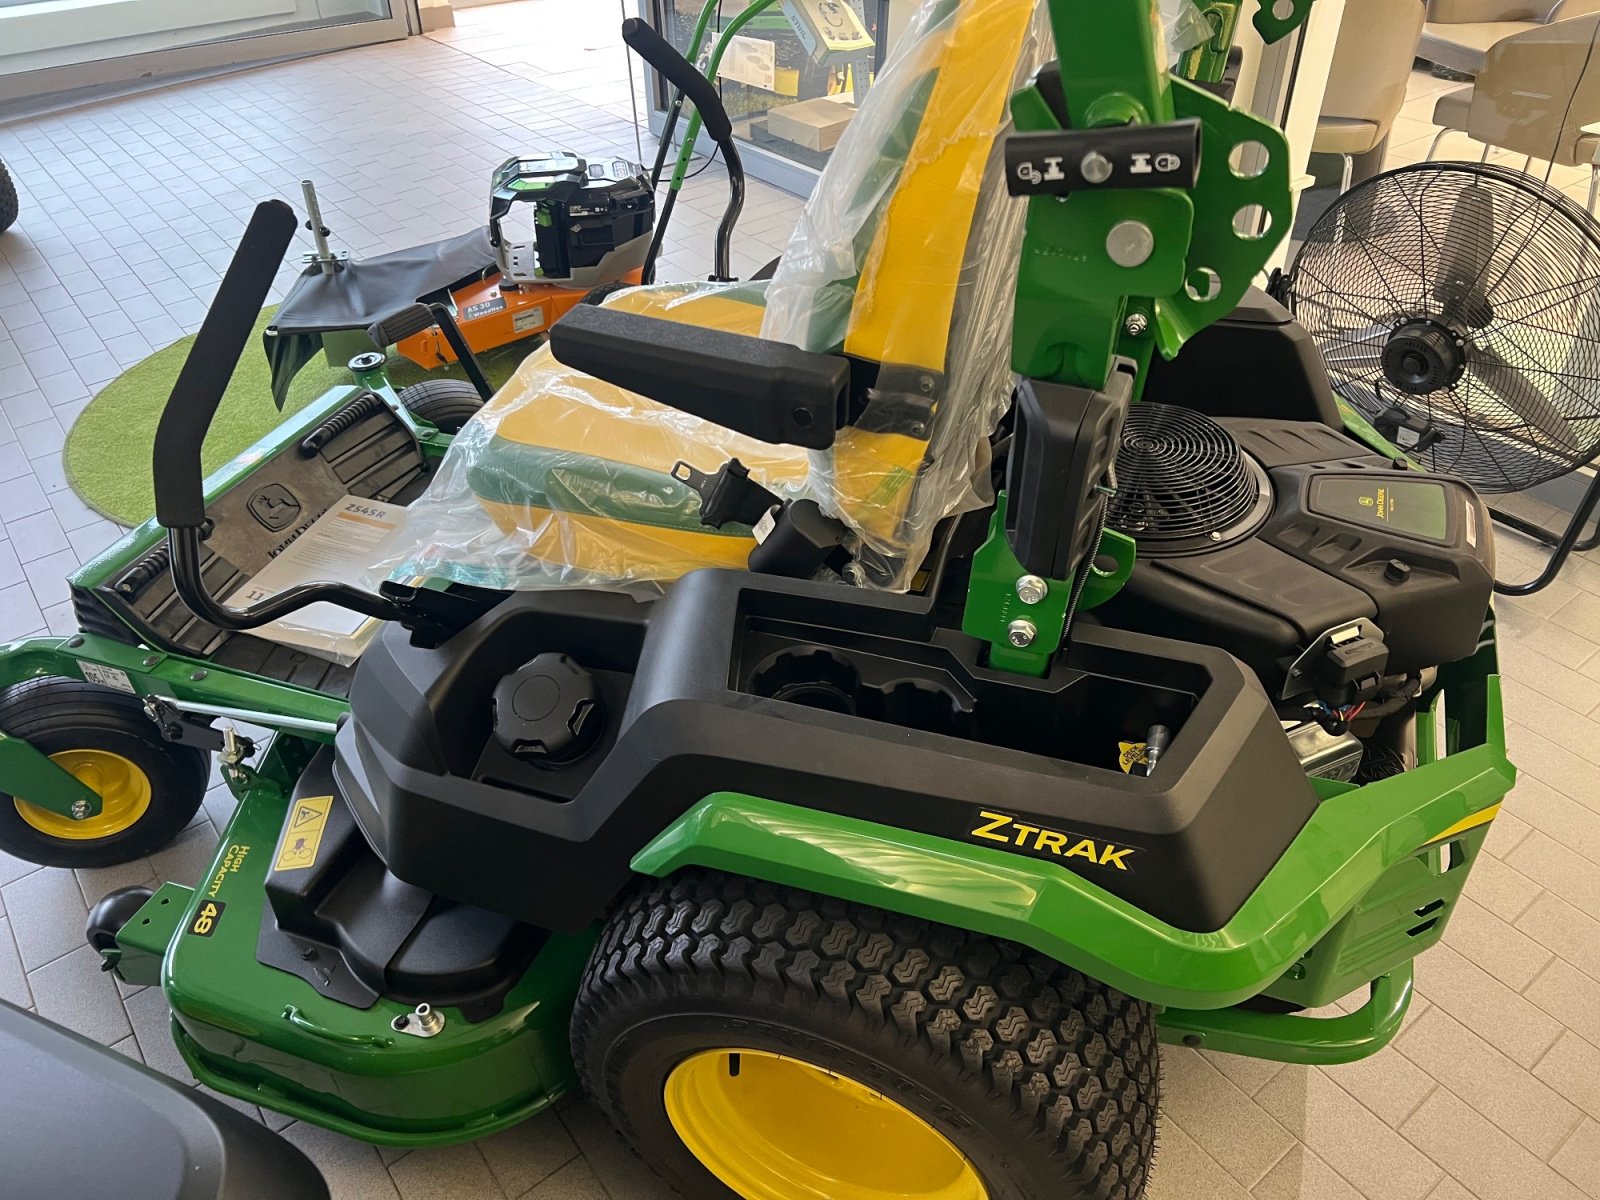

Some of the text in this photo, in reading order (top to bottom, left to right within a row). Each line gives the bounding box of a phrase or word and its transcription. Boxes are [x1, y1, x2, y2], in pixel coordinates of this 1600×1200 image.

[467, 301, 491, 313] AS 30
[345, 503, 387, 519] Z545R
[971, 810, 1135, 871] ZTRAK
[208, 844, 240, 898] CAPACITY
[230, 845, 251, 873] HIGH
[193, 902, 218, 934] 48
